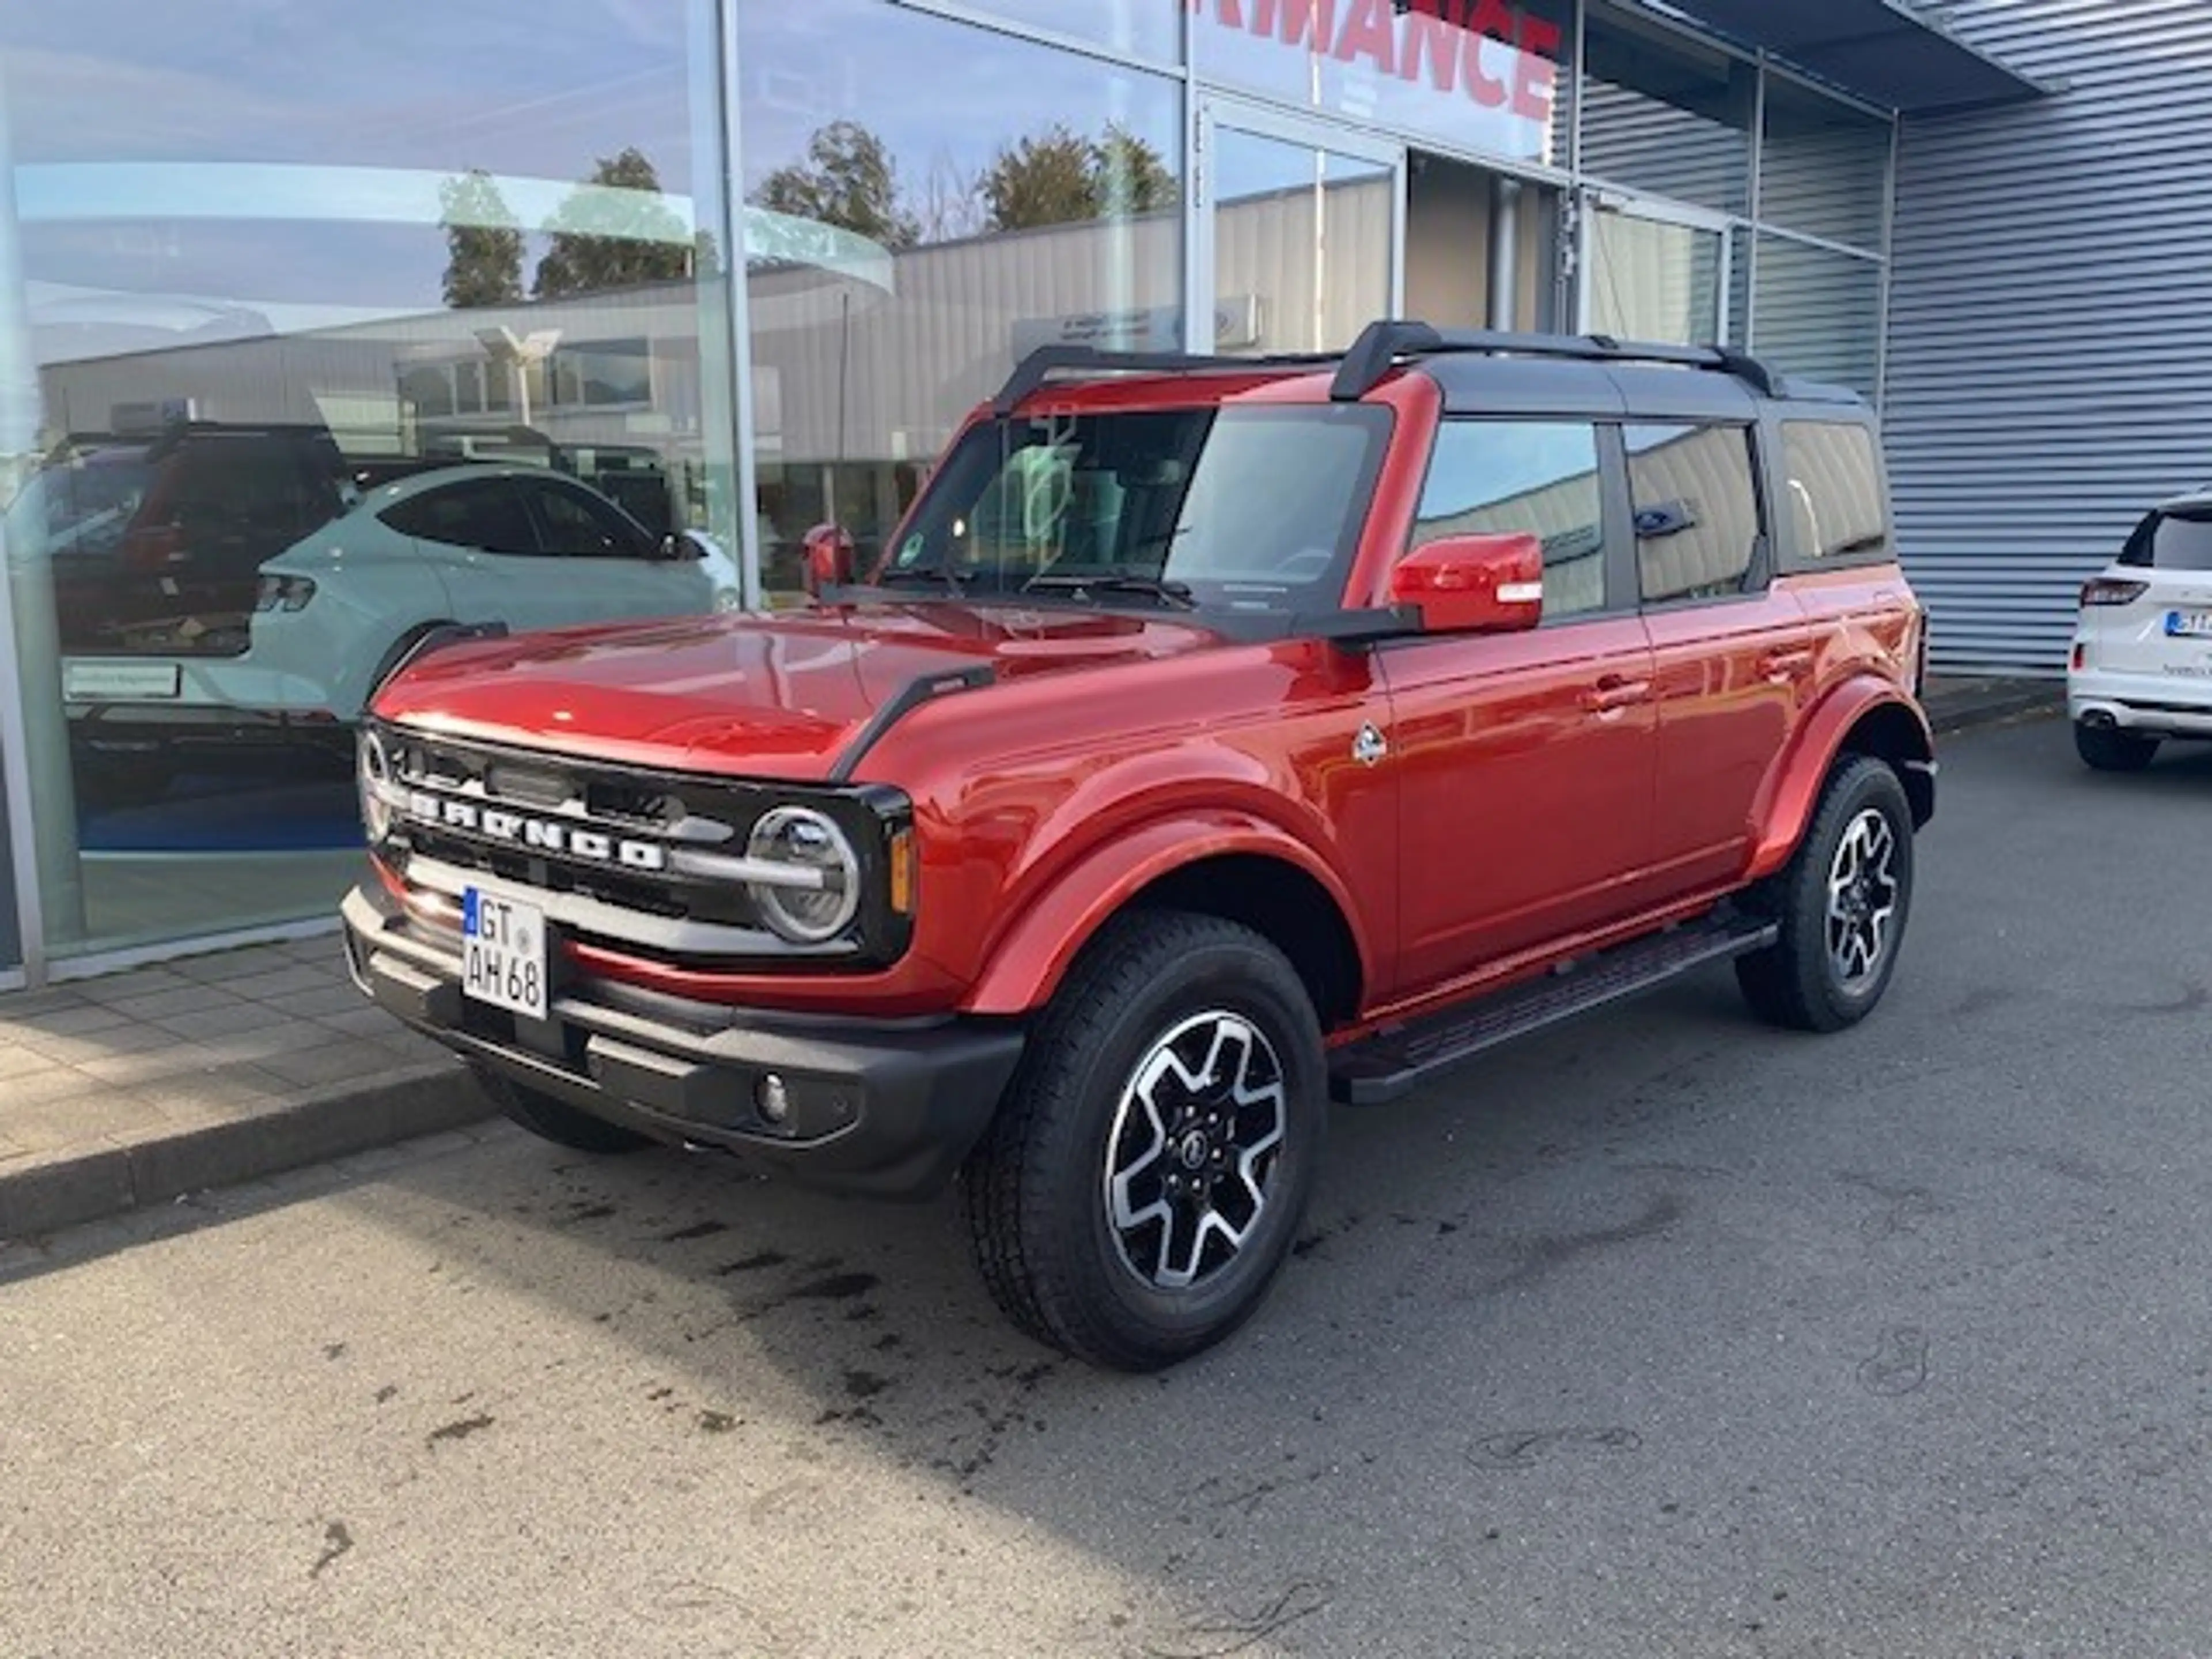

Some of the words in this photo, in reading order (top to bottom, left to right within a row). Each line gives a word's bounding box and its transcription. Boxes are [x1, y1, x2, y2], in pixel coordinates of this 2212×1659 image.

[1188, 0, 1559, 122] ANCE
[410, 794, 662, 868] BRONCO
[481, 899, 512, 947] GT
[507, 958, 540, 1007] 68
